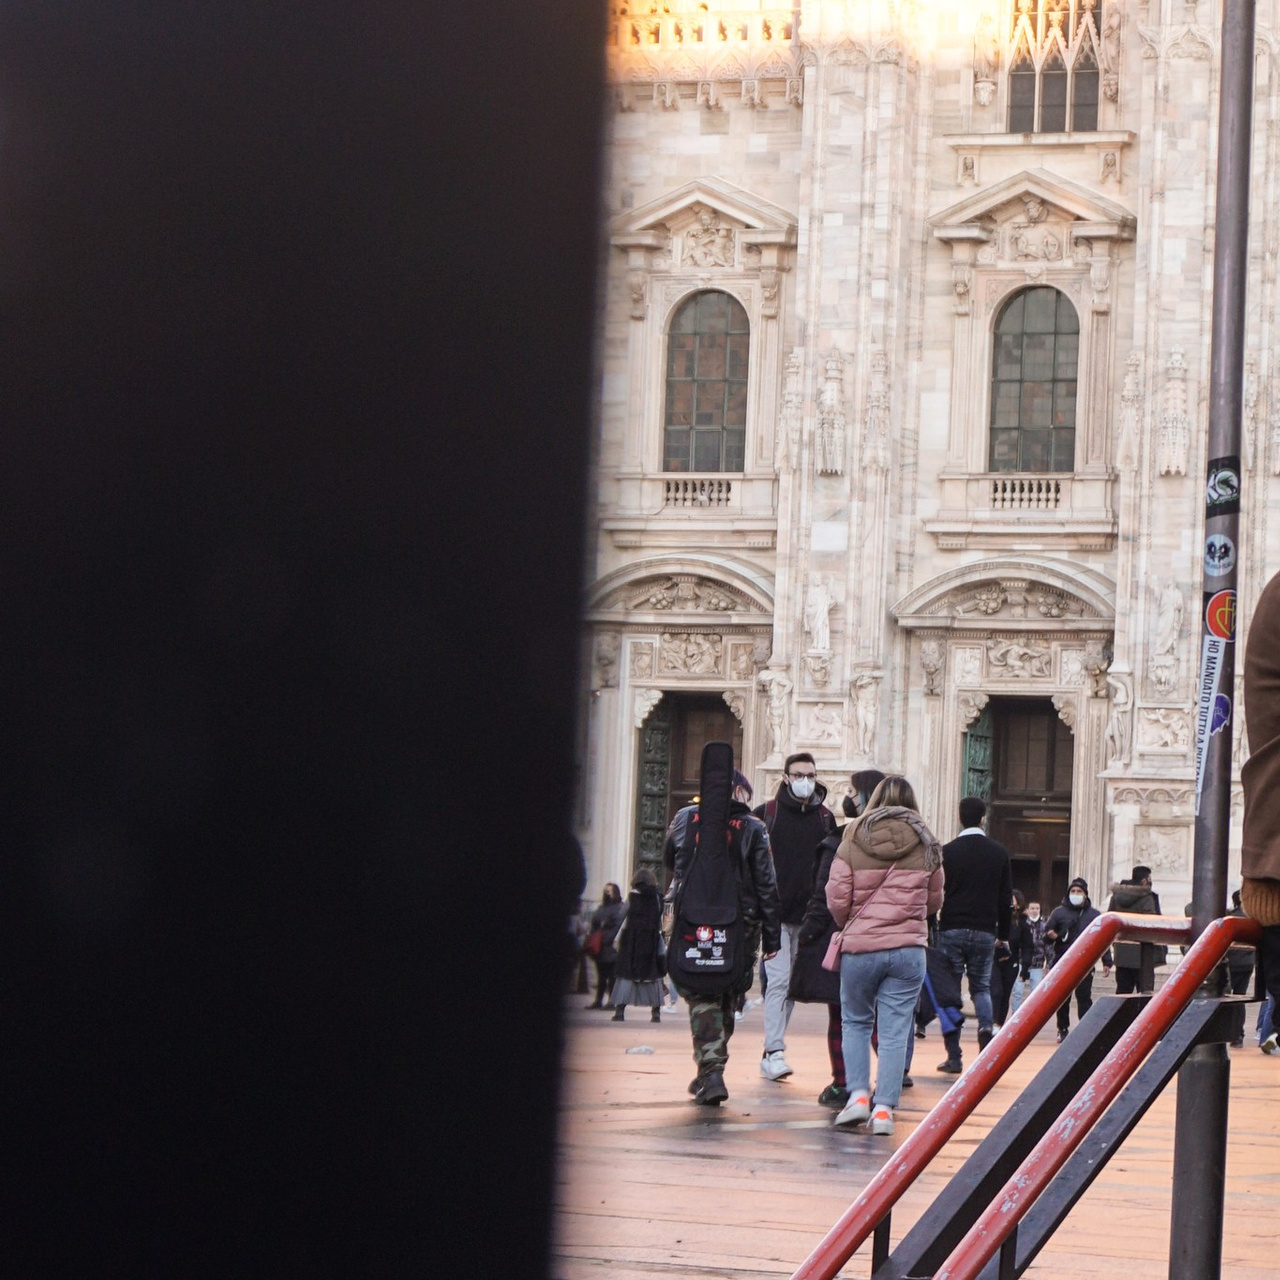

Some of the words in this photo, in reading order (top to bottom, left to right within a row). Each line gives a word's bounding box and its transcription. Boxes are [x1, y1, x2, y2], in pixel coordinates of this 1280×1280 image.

[1207, 639, 1221, 654] HO
[1200, 656, 1218, 703] MANDATO
[1198, 706, 1210, 736] TUTTO
